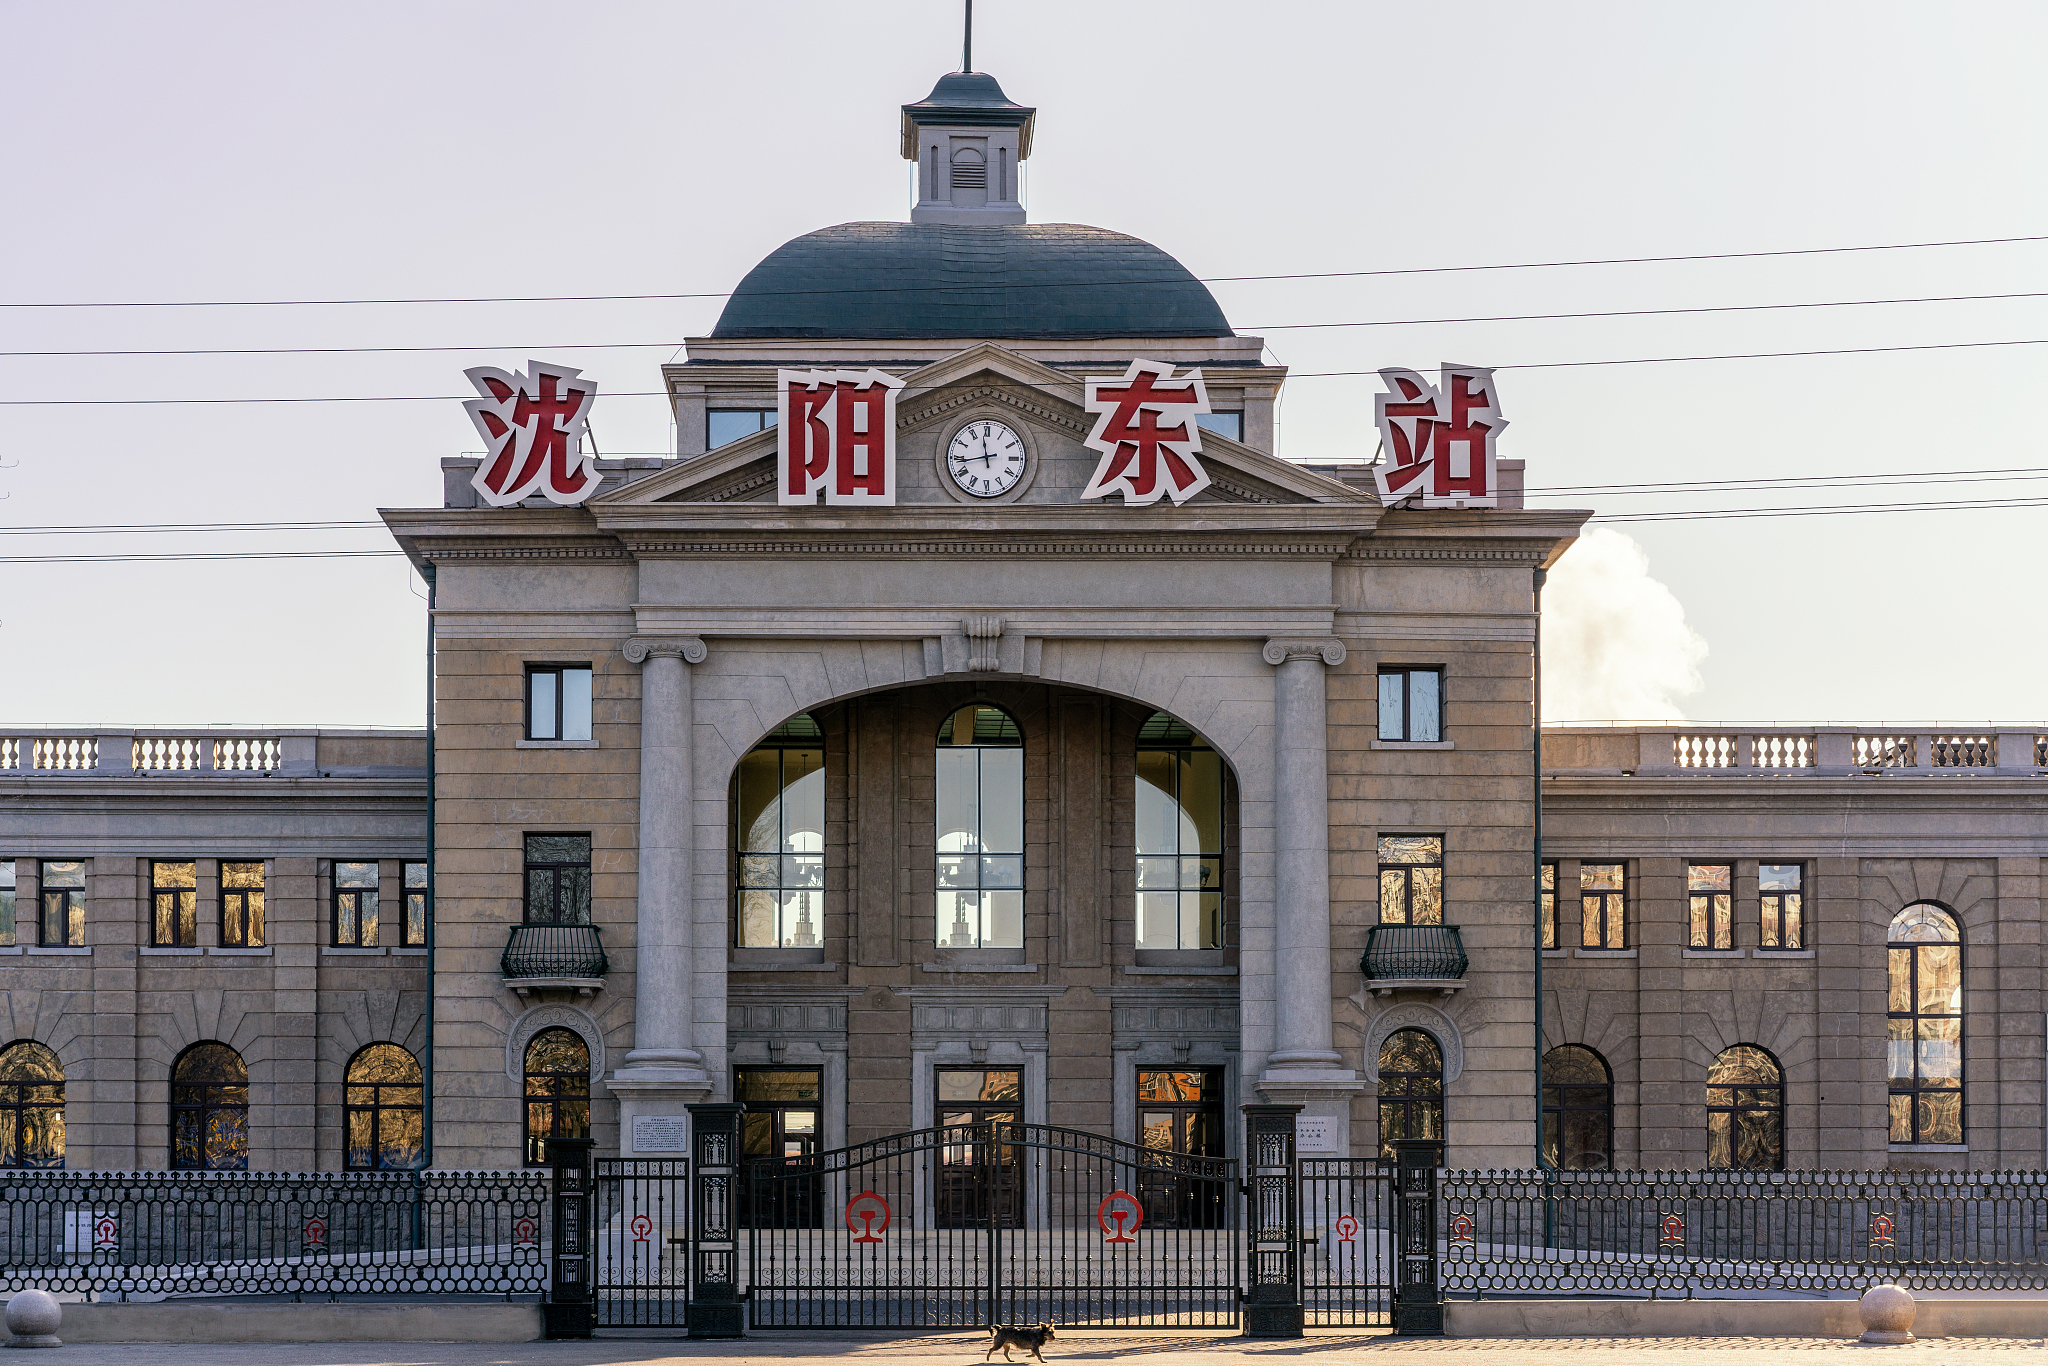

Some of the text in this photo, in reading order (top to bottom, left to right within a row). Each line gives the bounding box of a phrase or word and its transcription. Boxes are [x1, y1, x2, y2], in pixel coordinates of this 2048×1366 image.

[468, 362, 1502, 503] 沈阳东站
[997, 430, 1004, 440] I
[957, 440, 969, 449] X
[995, 476, 1003, 487] V
